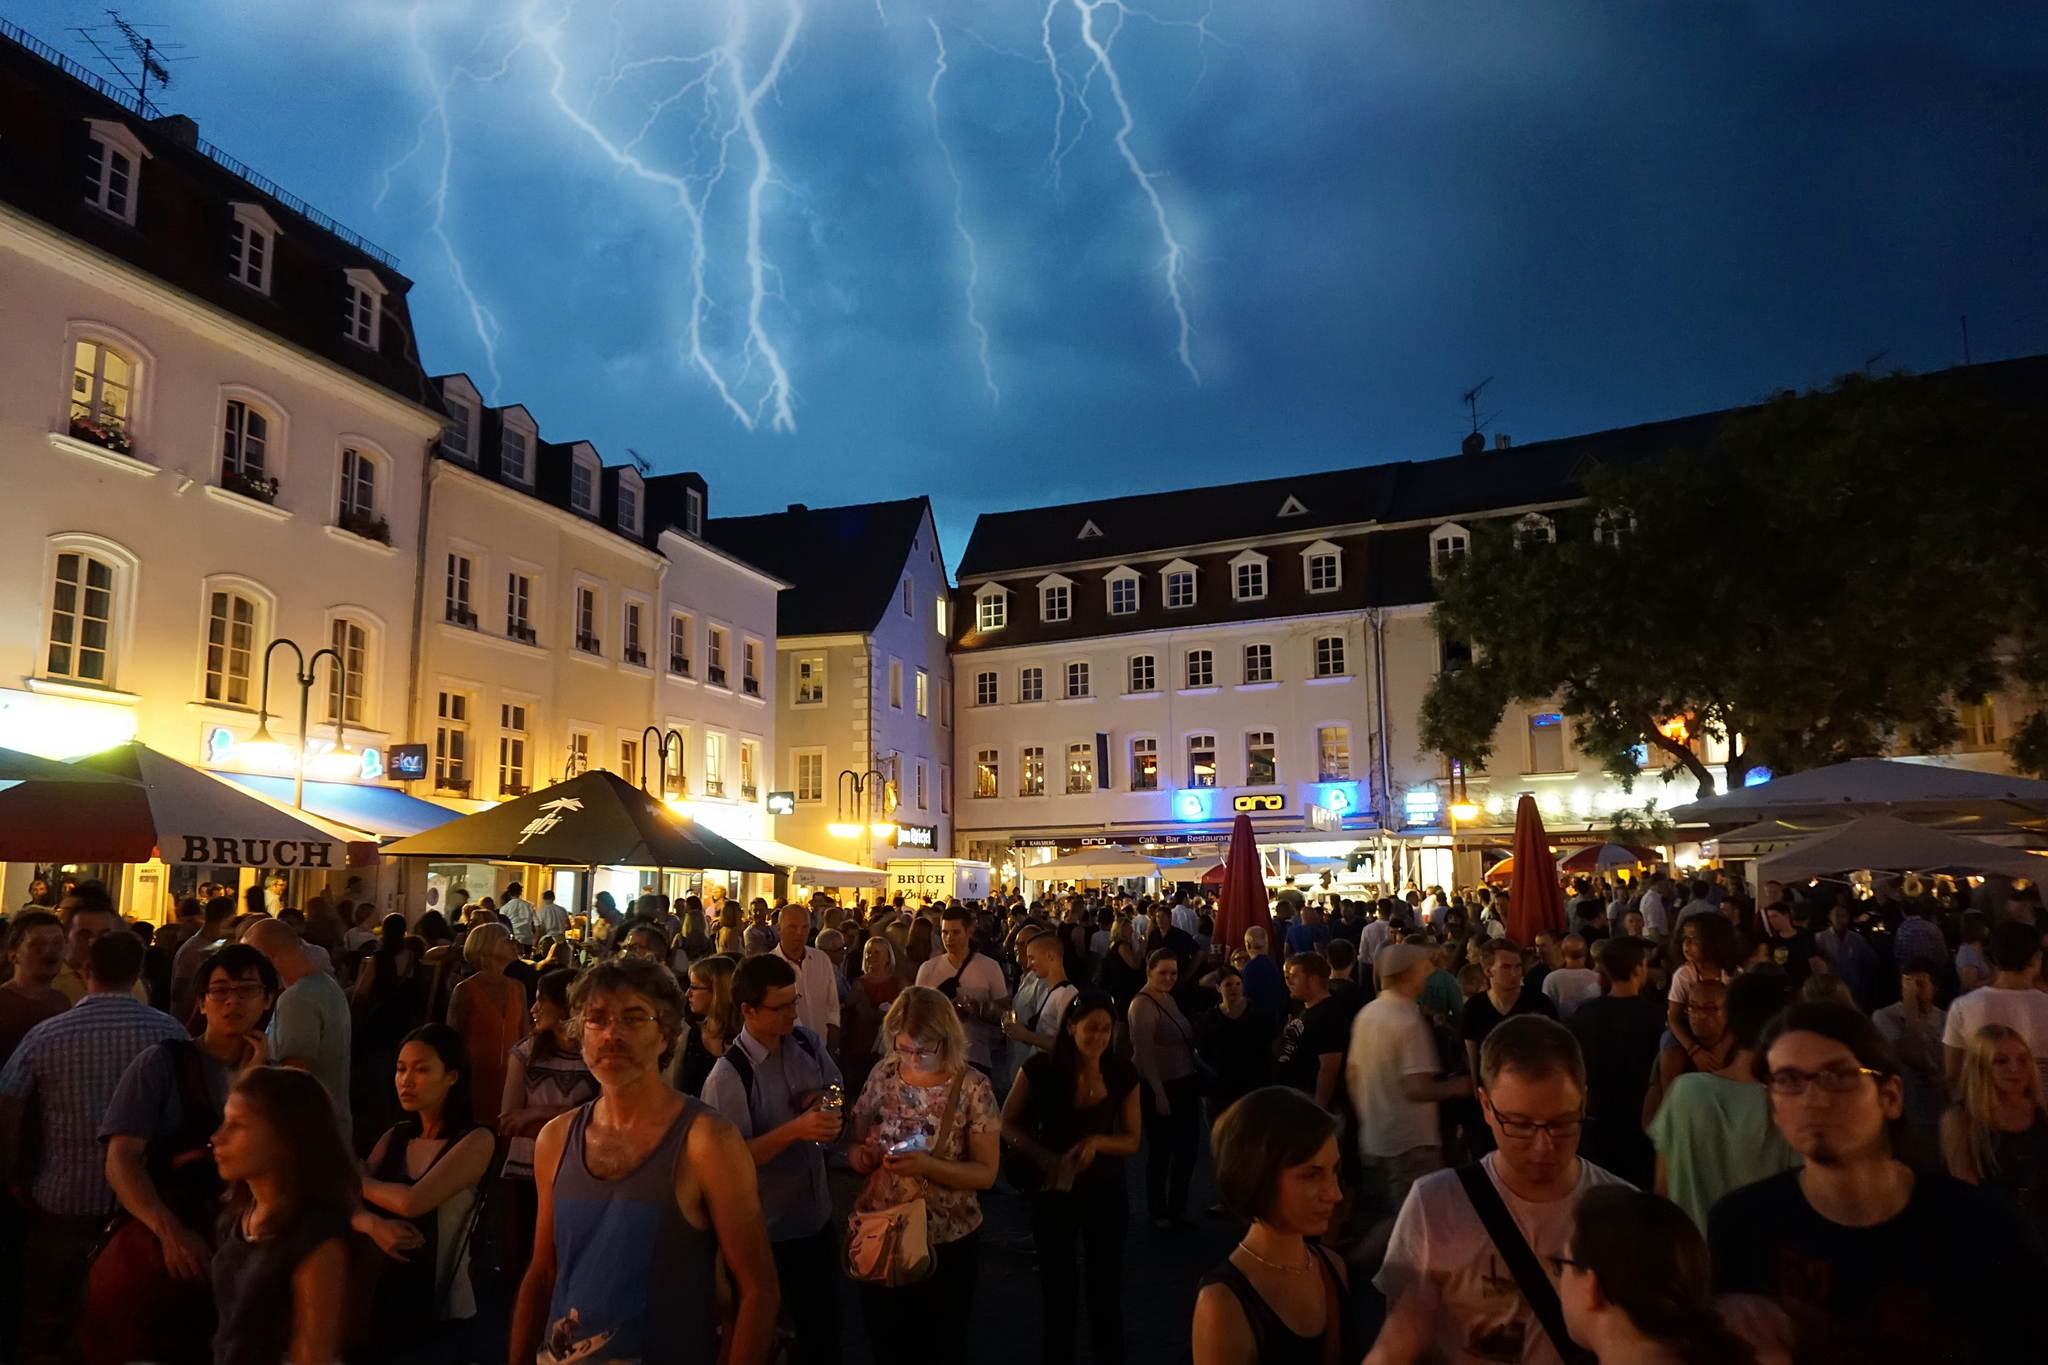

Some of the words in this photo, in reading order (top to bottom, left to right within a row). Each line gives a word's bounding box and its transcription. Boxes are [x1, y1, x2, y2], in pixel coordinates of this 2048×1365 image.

[391, 752, 420, 771] sky
[1234, 795, 1283, 811] oro
[1139, 834, 1158, 844] Café
[1166, 836, 1180, 844] Bar
[181, 835, 332, 867] BRUCH
[897, 875, 945, 884] BRUCH
